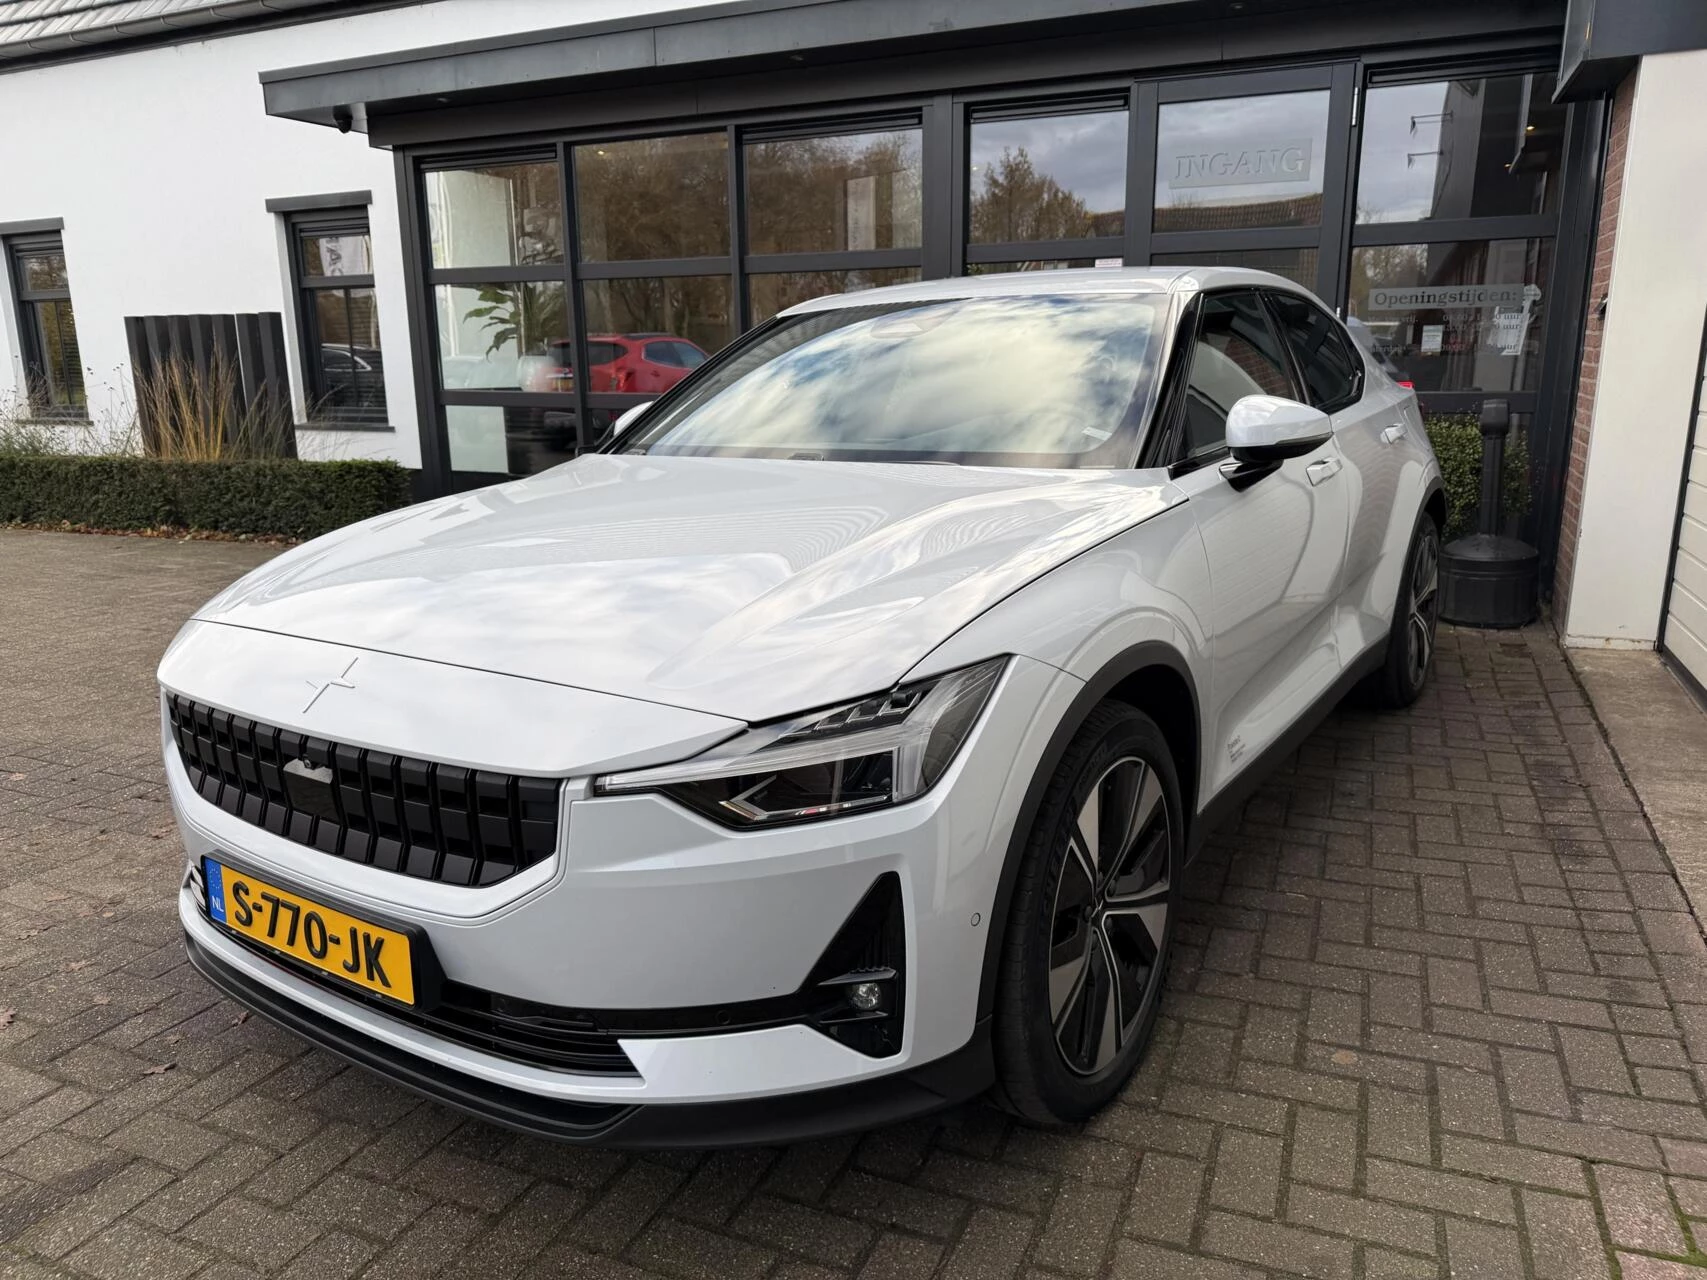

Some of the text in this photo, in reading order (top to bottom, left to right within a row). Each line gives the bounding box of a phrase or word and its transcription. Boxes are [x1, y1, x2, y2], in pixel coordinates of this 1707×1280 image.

[1175, 147, 1307, 179] INGANG
[1374, 288, 1518, 308] Openingstijden:
[211, 895, 224, 913] NL
[232, 880, 392, 988] S-770-JK
